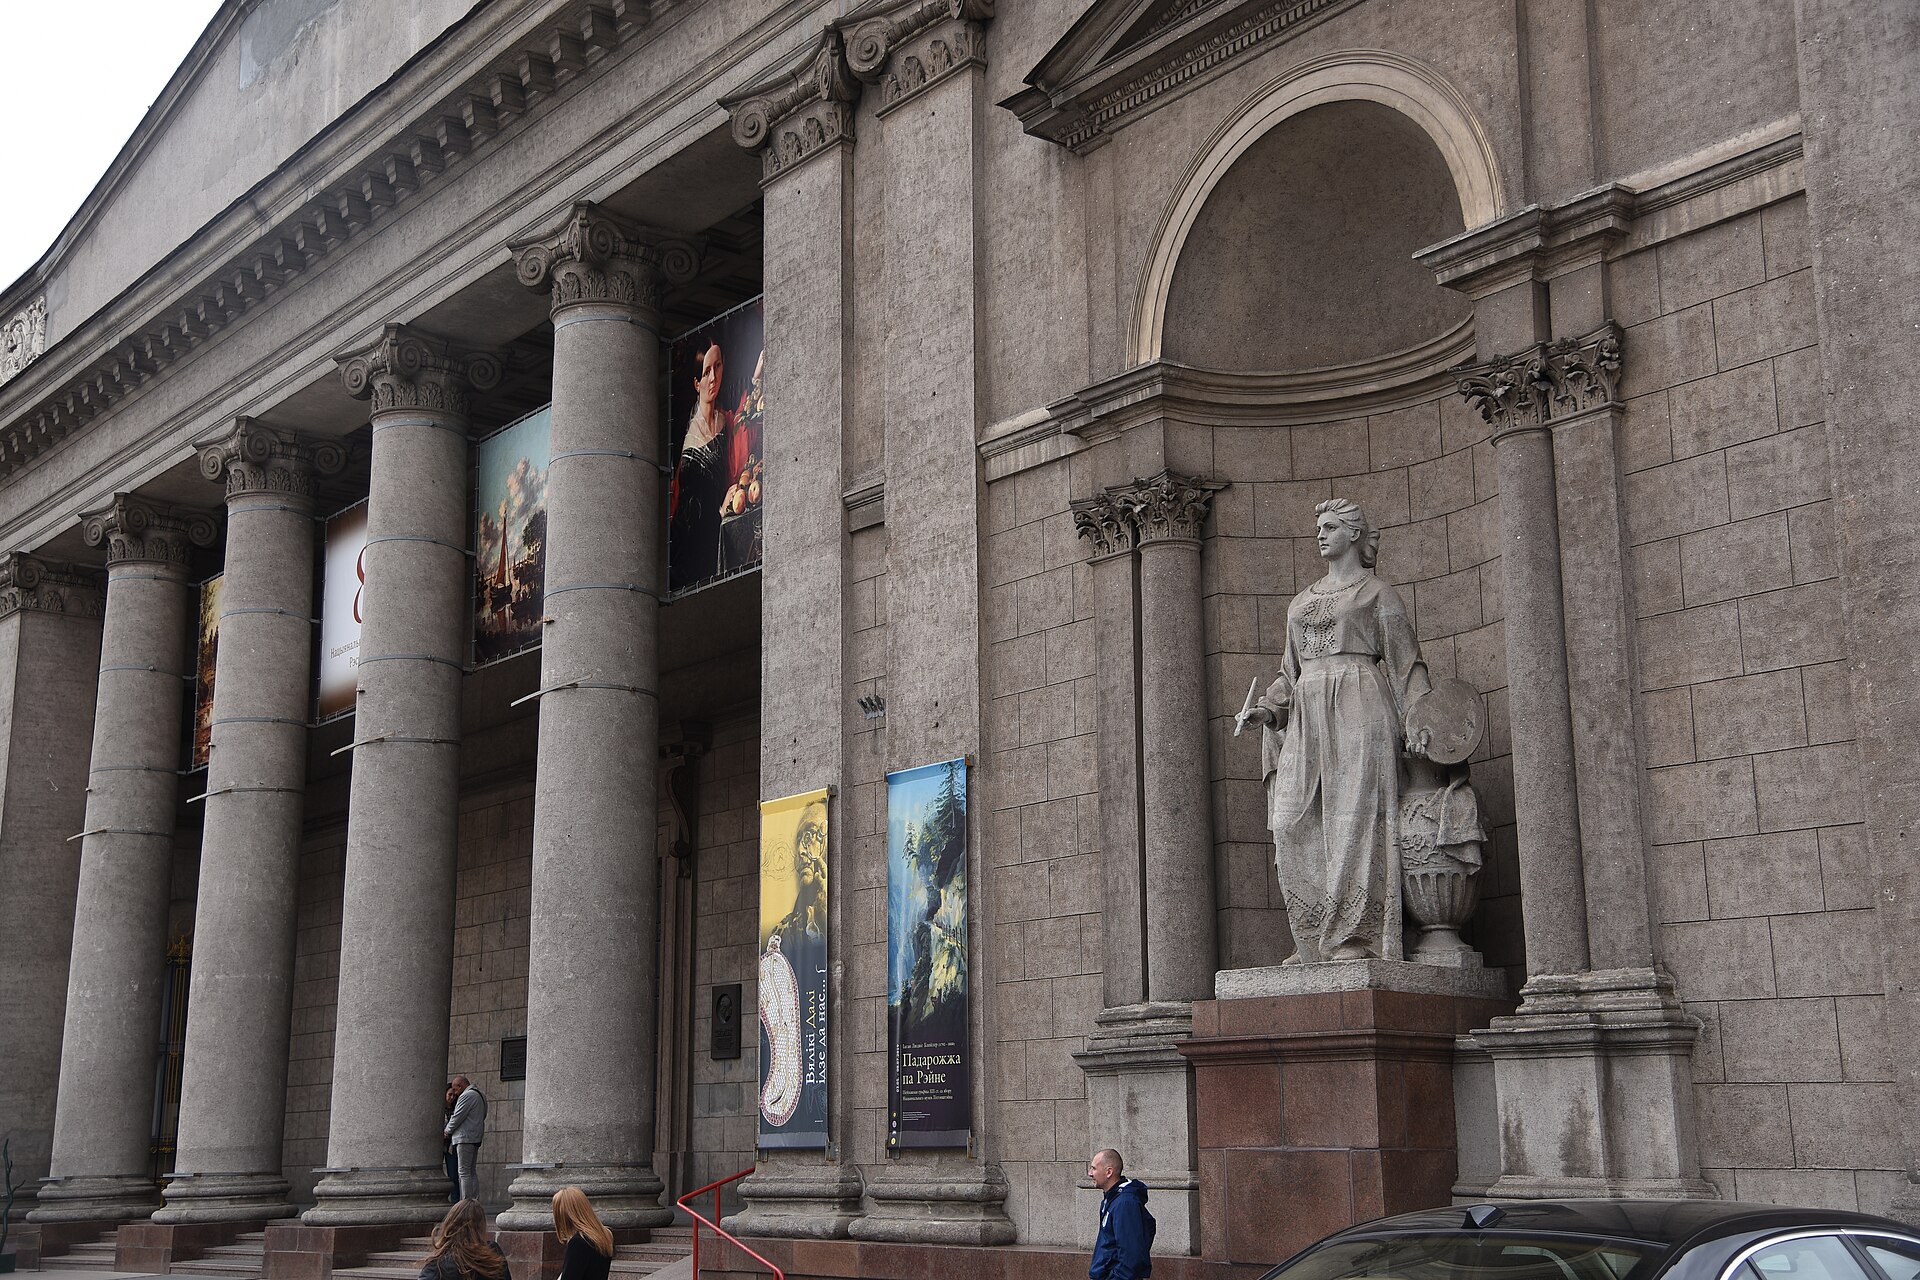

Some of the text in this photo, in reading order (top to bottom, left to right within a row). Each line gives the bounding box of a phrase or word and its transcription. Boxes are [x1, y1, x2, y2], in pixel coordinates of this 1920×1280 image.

[330, 638, 361, 660] Нацыяналь
[805, 990, 816, 1085] Вялікі Далі
[816, 979, 827, 1084] ідзе да нас...
[902, 1053, 961, 1070] Падарожжа
[902, 1070, 946, 1085] па Рэйне
